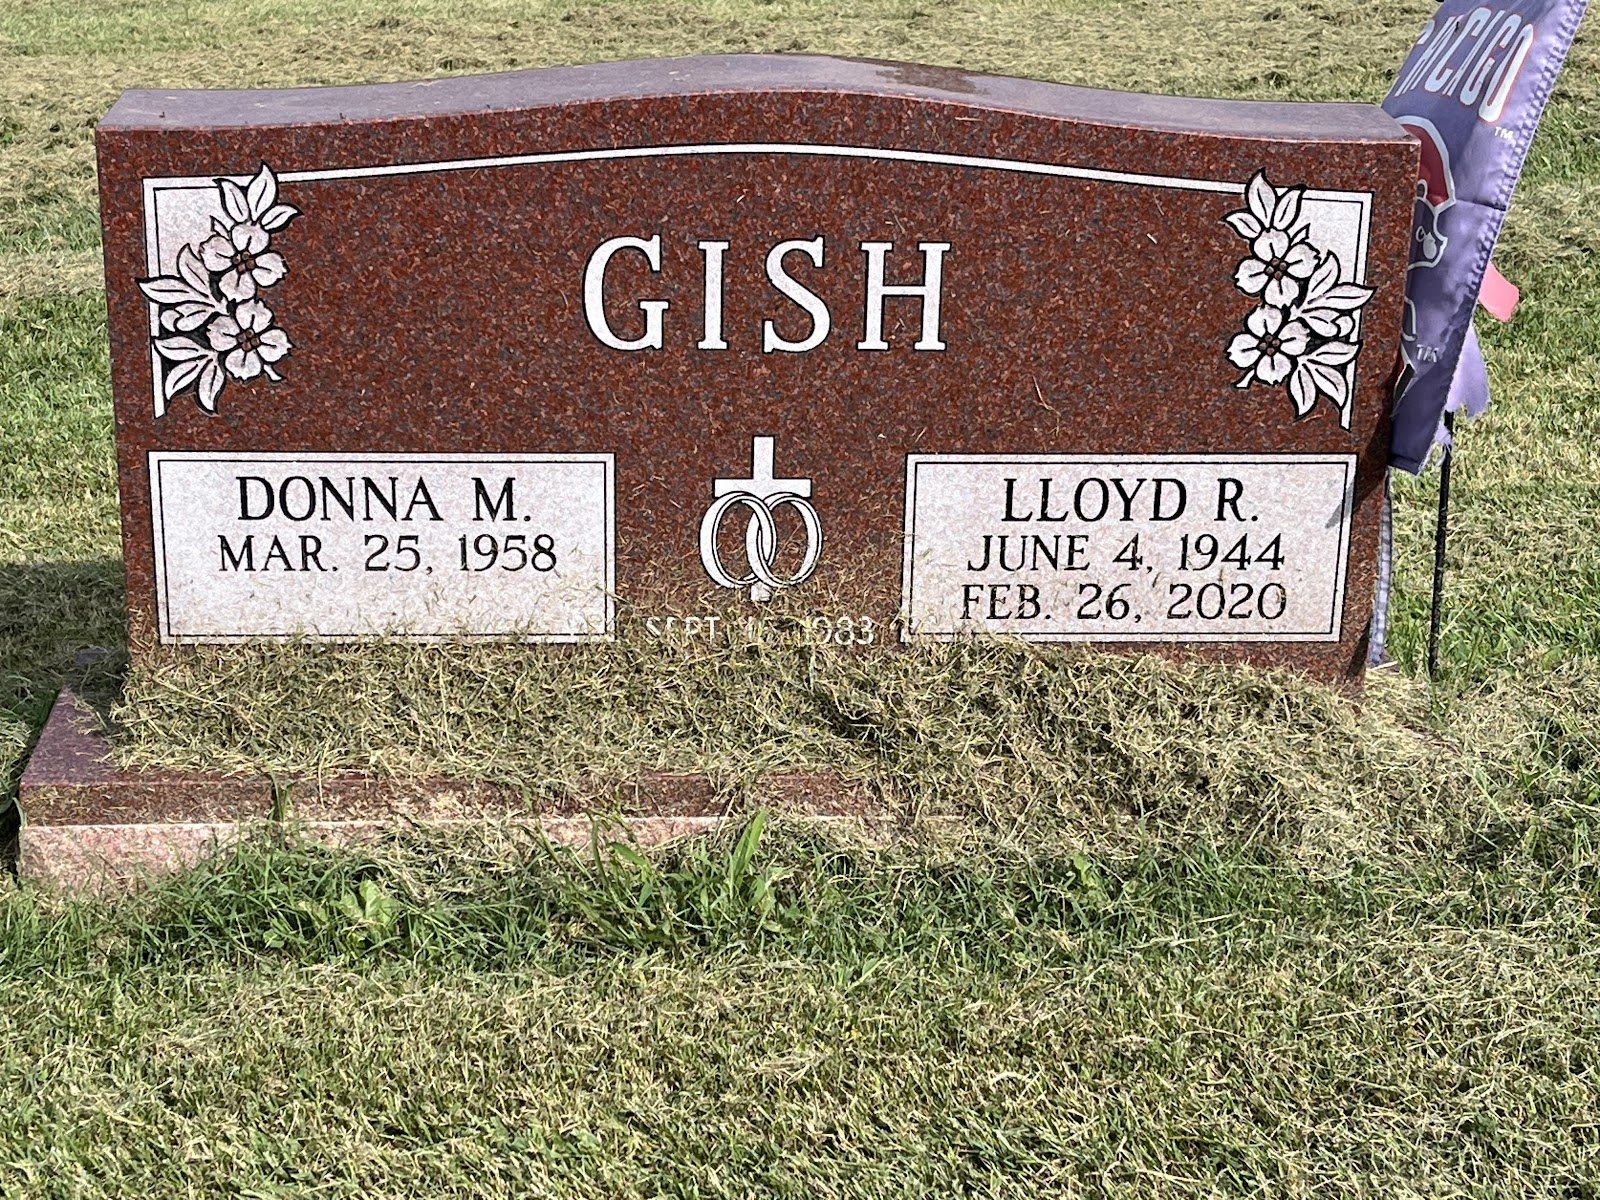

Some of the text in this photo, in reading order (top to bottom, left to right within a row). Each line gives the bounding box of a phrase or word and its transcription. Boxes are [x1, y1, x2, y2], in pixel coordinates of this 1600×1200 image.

[583, 234, 952, 354] GISH
[235, 475, 532, 523] DONNA M.
[1000, 477, 1260, 523] LLOYD R.
[217, 533, 557, 575] MAR. 25, 1958
[967, 532, 1286, 574] JUNE 4, 1944
[960, 582, 1287, 624] FEB. 26, 2020
